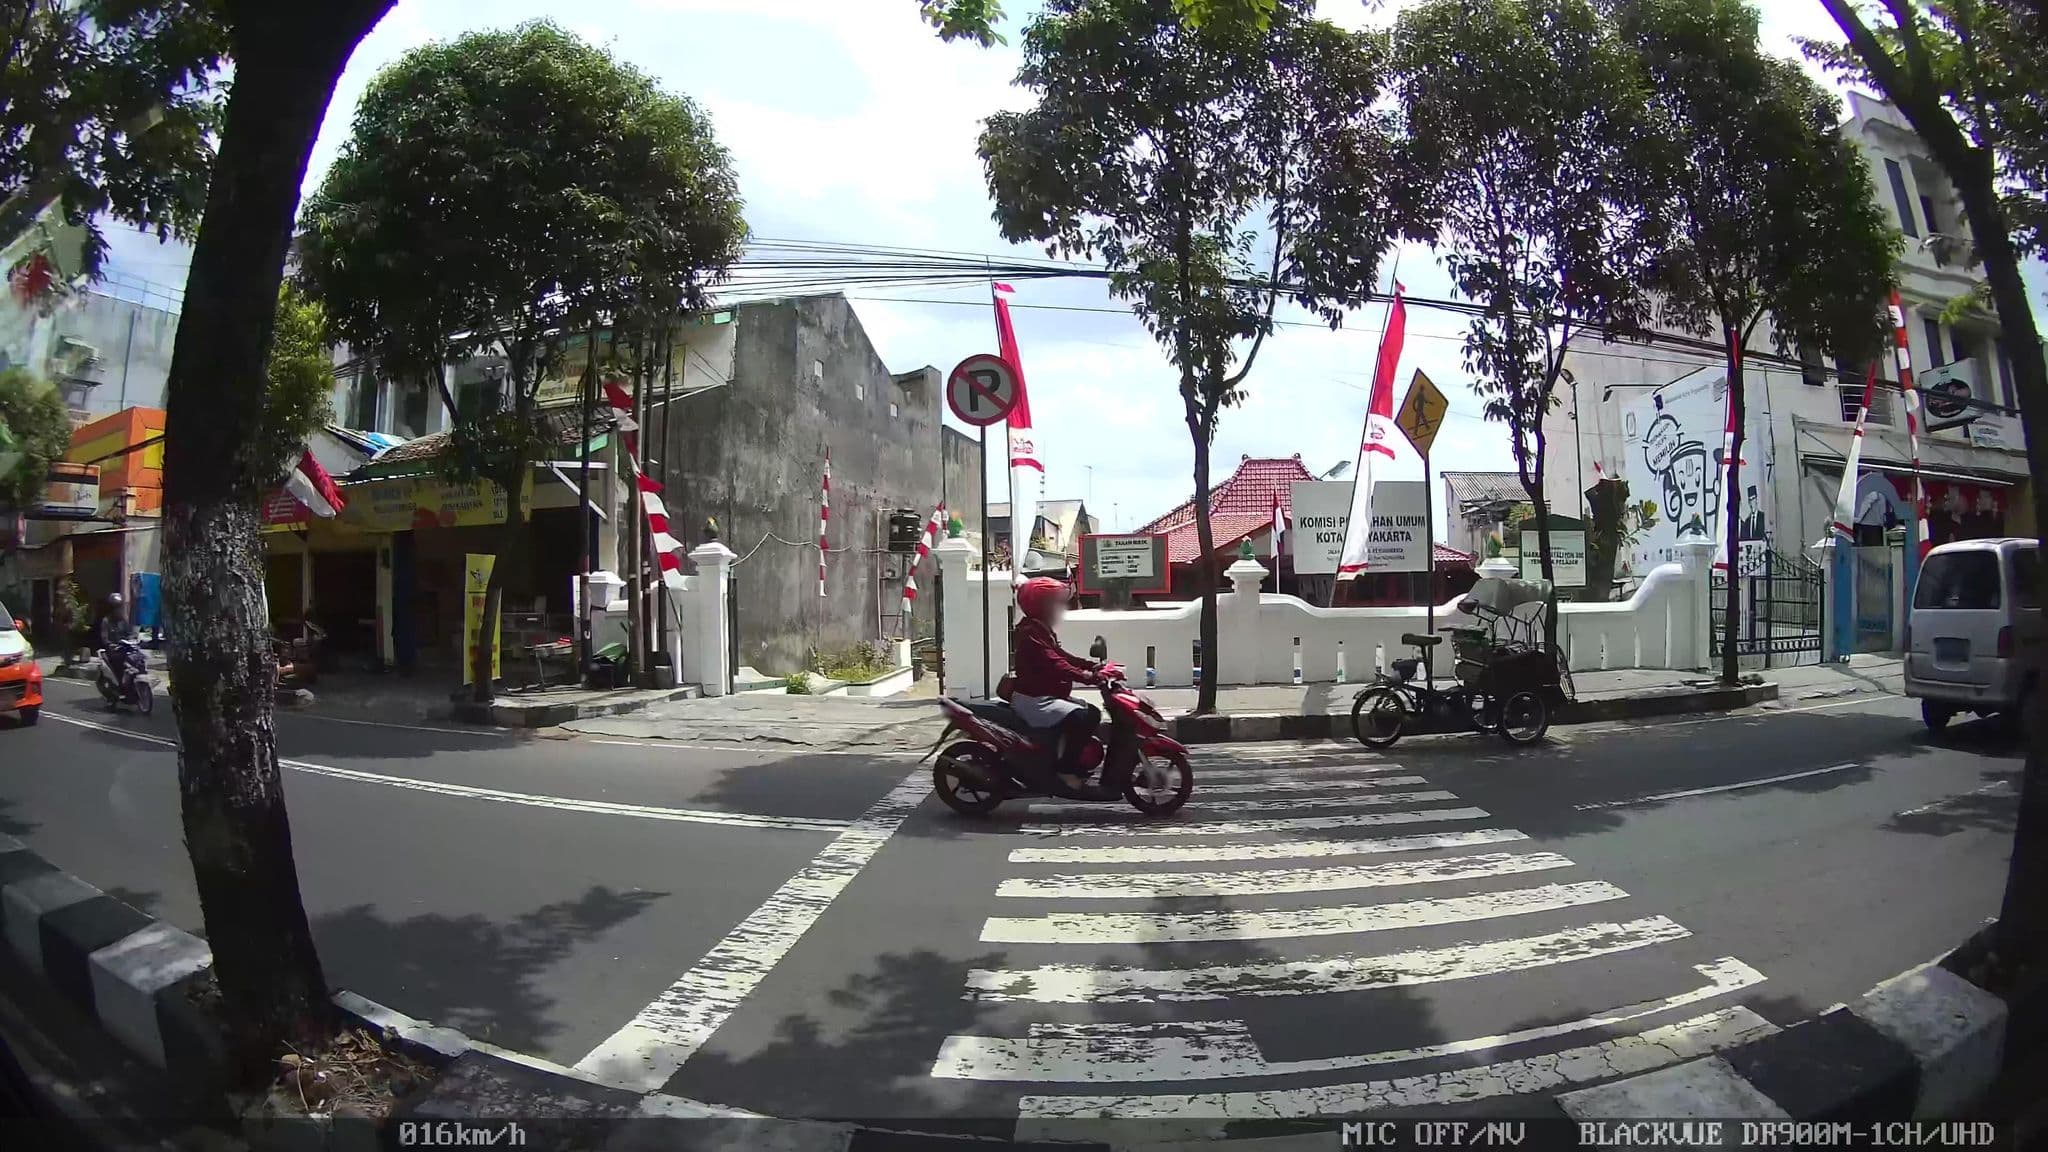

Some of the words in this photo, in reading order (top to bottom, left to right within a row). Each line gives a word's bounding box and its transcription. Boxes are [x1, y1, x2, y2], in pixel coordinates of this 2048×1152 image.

[968, 369, 1001, 412] P
[1300, 516, 1336, 528] KOMISI
[1396, 515, 1426, 528] UMUM
[1316, 531, 1343, 543] KOTA
